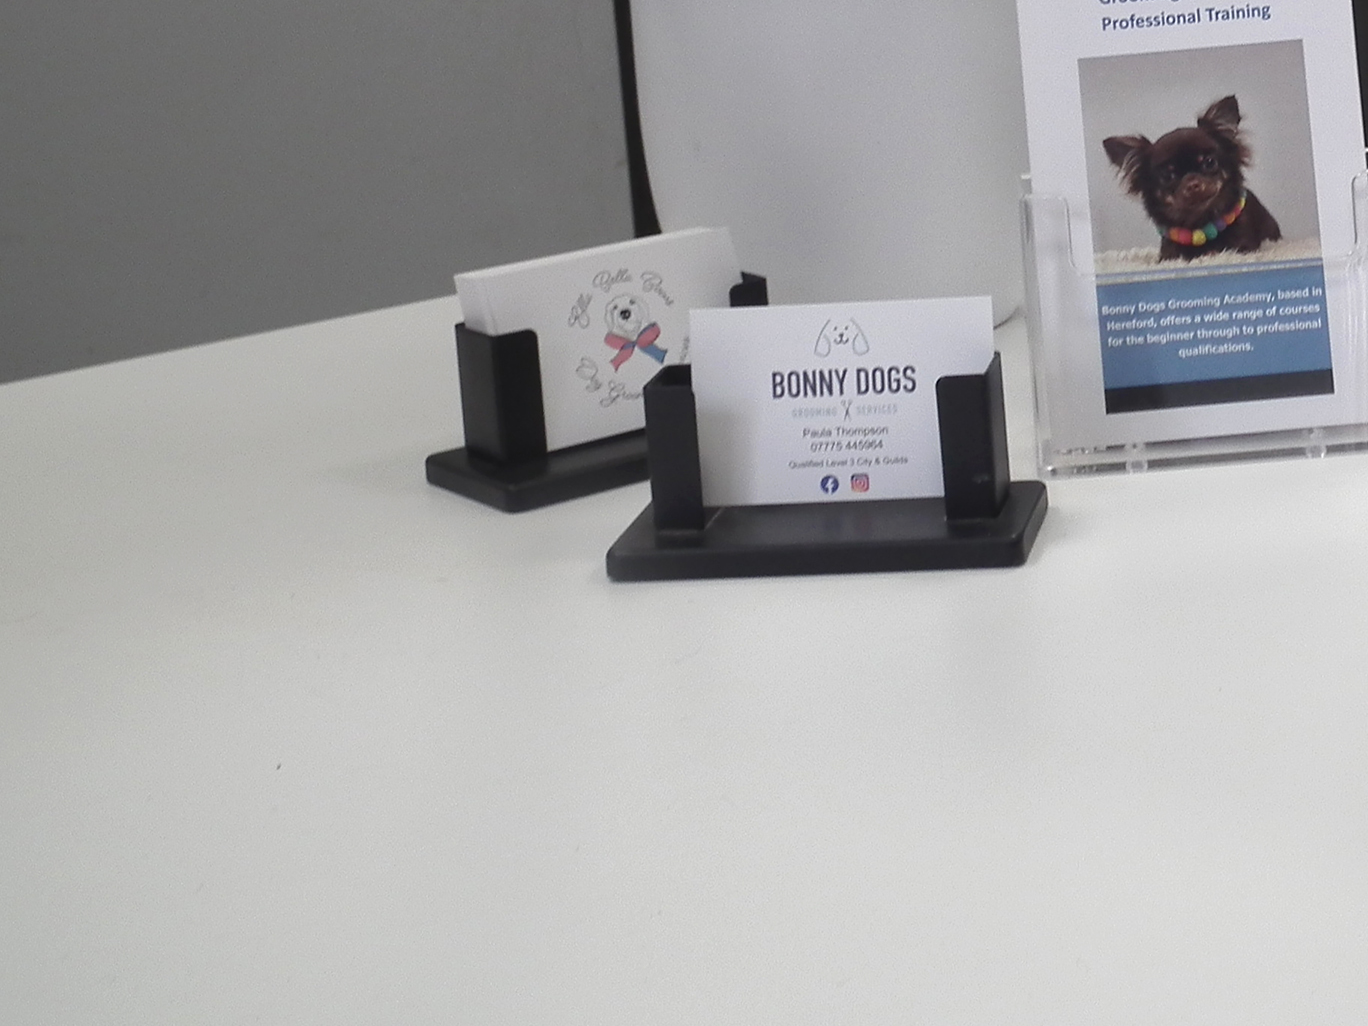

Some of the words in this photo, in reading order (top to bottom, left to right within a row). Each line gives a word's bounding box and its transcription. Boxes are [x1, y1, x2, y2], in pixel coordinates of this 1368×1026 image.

[1101, 8, 1201, 32] Professional
[1205, 2, 1272, 23] Training
[1101, 304, 1136, 316] Bonny
[1138, 302, 1165, 314] Dogs
[1168, 296, 1220, 309] Grooming
[1223, 292, 1275, 305] Academy,
[1277, 287, 1309, 300] based
[1312, 286, 1322, 297] in
[1106, 317, 1158, 332] Hereford,
[1160, 314, 1192, 327] offers
[1194, 314, 1201, 323] a
[1203, 310, 1229, 322] wide
[1232, 309, 1263, 321] range
[1265, 305, 1277, 317] of
[1279, 303, 1320, 316] courses
[1107, 336, 1124, 348] for
[1126, 335, 1144, 346] the
[1146, 331, 1194, 345] beginner
[1197, 326, 1240, 339] through
[1242, 324, 1254, 335] to
[1256, 317, 1322, 336] professional
[1178, 341, 1254, 359] qualifications.
[771, 368, 848, 399] BONNY
[856, 365, 917, 395] DOGS
[856, 403, 898, 416] SERVICES
[802, 427, 833, 440] Paula
[835, 425, 889, 440] Thompson
[788, 458, 824, 469] Qualified
[825, 457, 848, 468] Level
[856, 456, 873, 468] City
